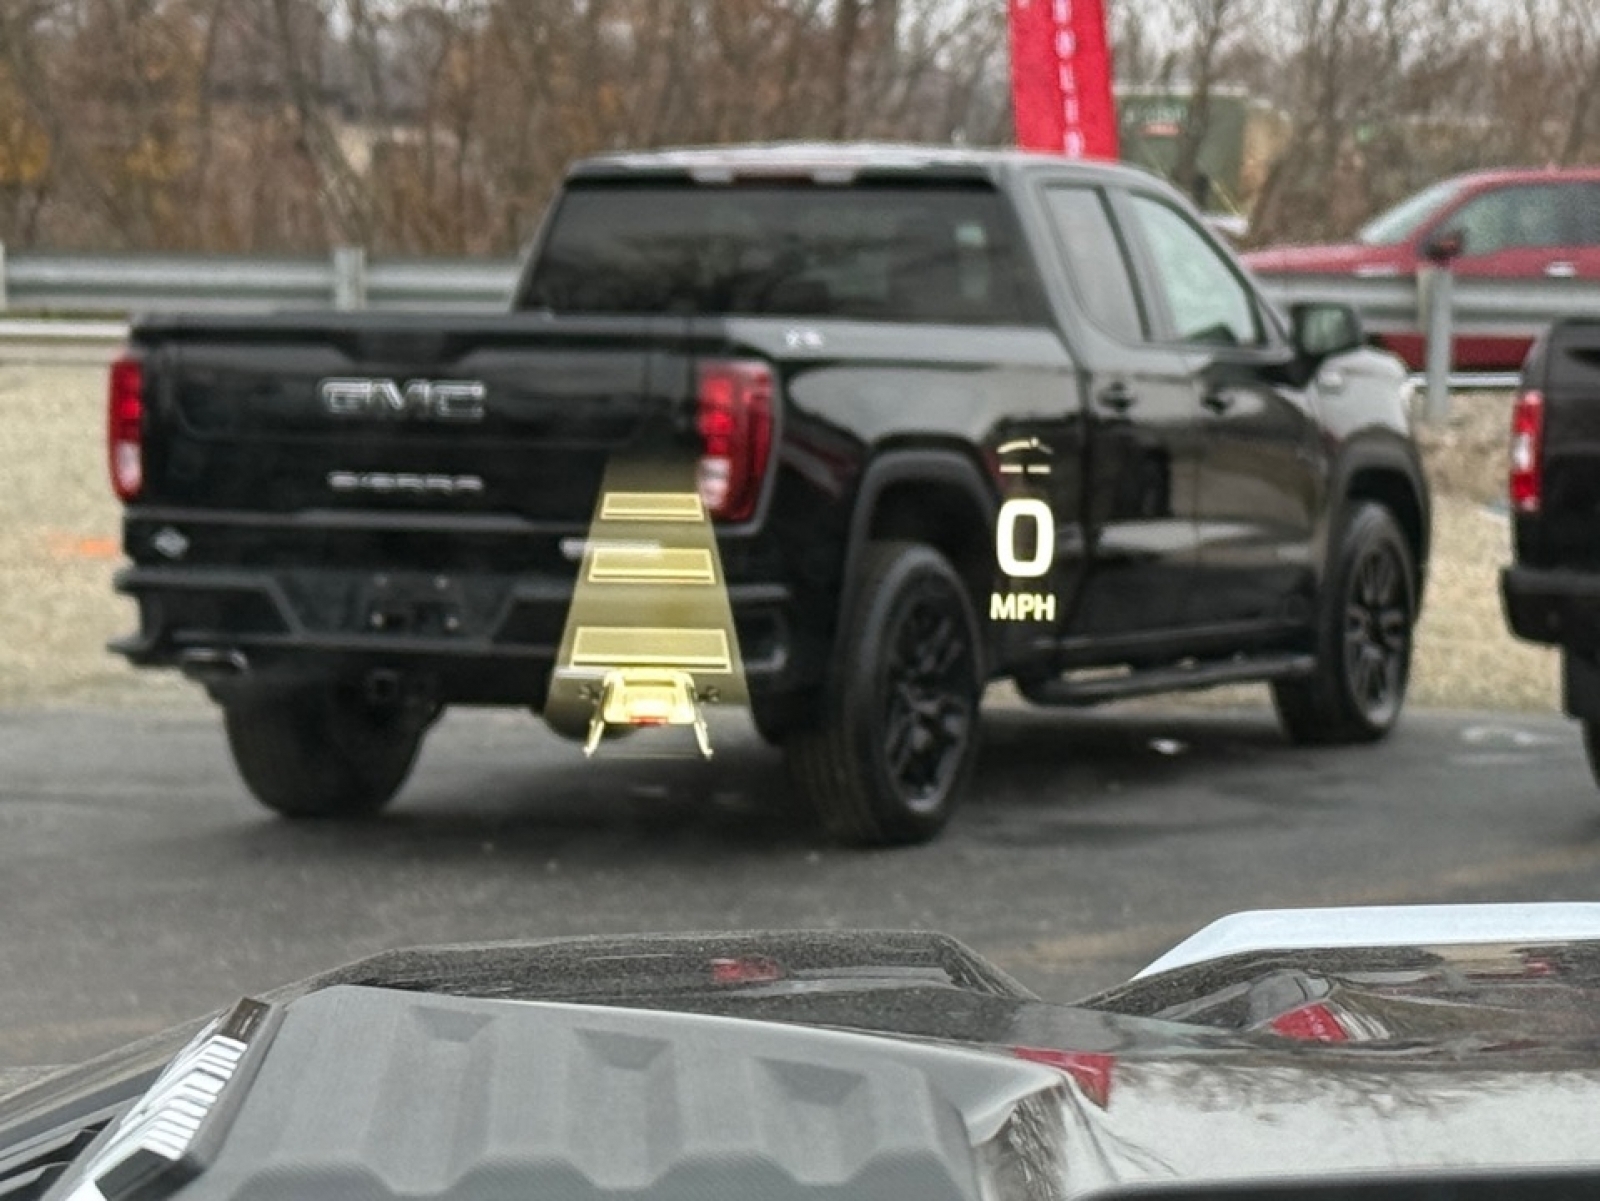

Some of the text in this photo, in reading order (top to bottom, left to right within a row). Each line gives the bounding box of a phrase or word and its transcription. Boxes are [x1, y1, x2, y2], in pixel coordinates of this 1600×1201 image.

[320, 378, 486, 421] GMC
[997, 498, 1054, 577] 0
[990, 593, 1056, 620] MPH
